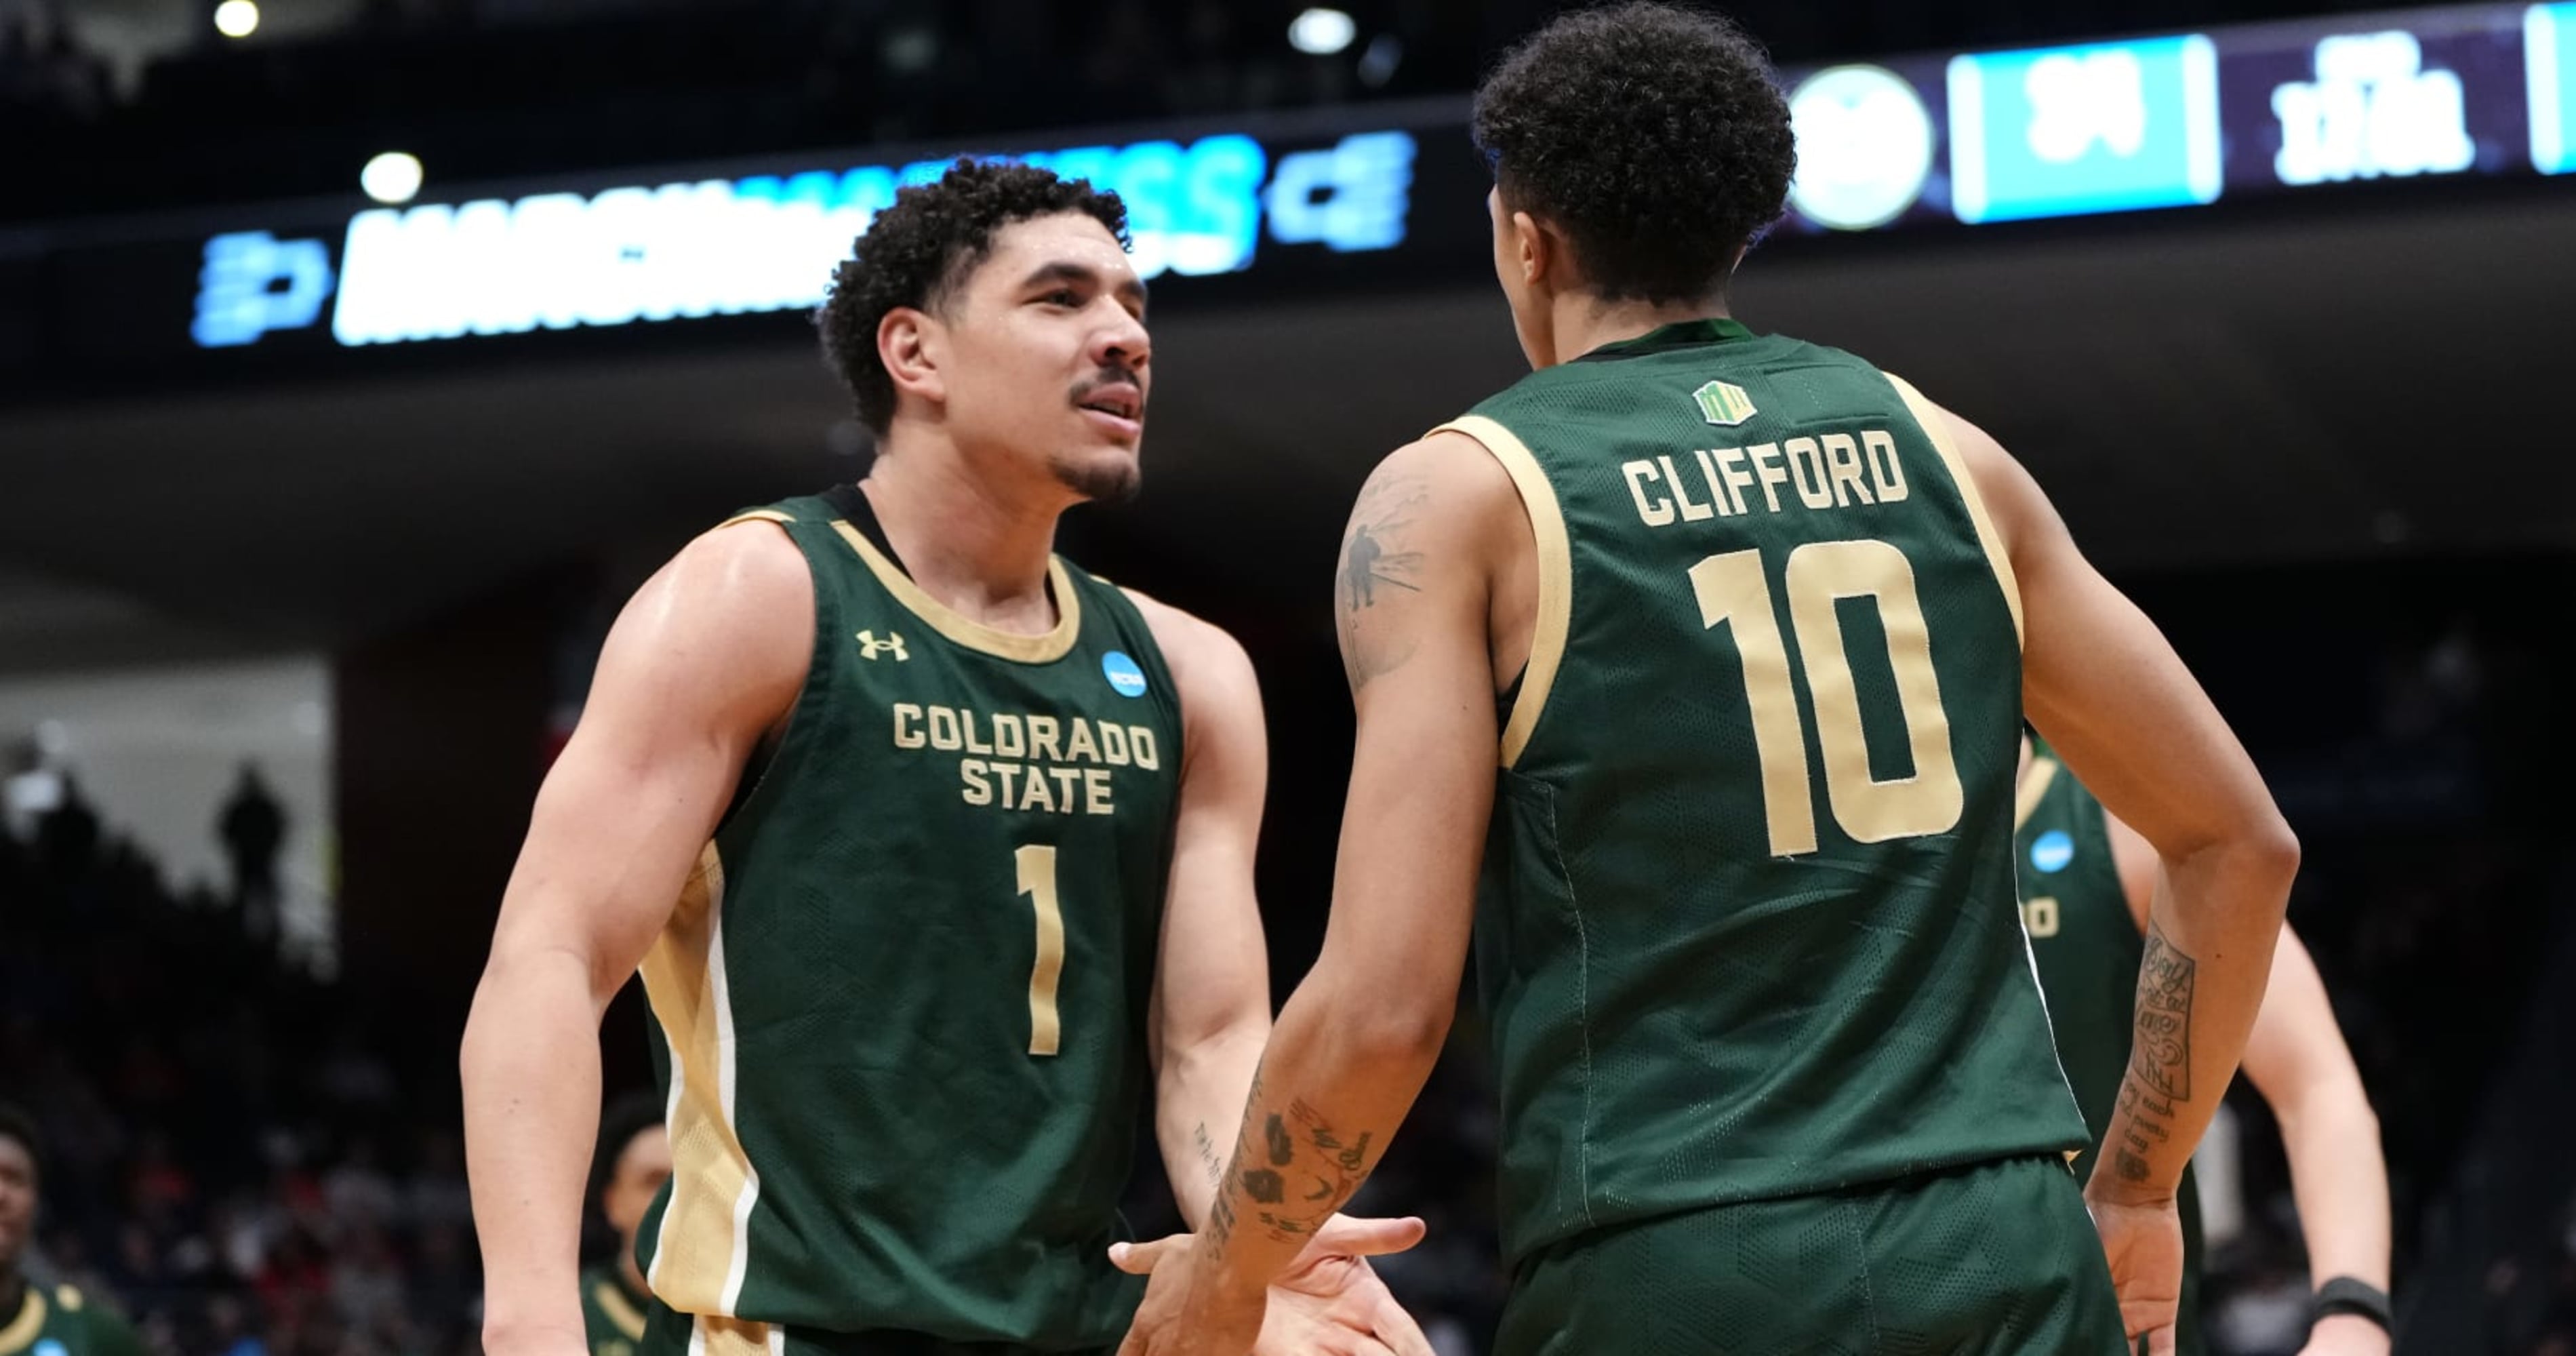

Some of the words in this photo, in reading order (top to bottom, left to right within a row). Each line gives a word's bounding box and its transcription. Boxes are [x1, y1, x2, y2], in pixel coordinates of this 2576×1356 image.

[1622, 430, 1910, 527] CLIFFORD
[893, 703, 1159, 770] COLORADO
[1687, 539, 1964, 857] 10
[961, 759, 1114, 814] STATE
[1015, 844, 1065, 1055] 1
